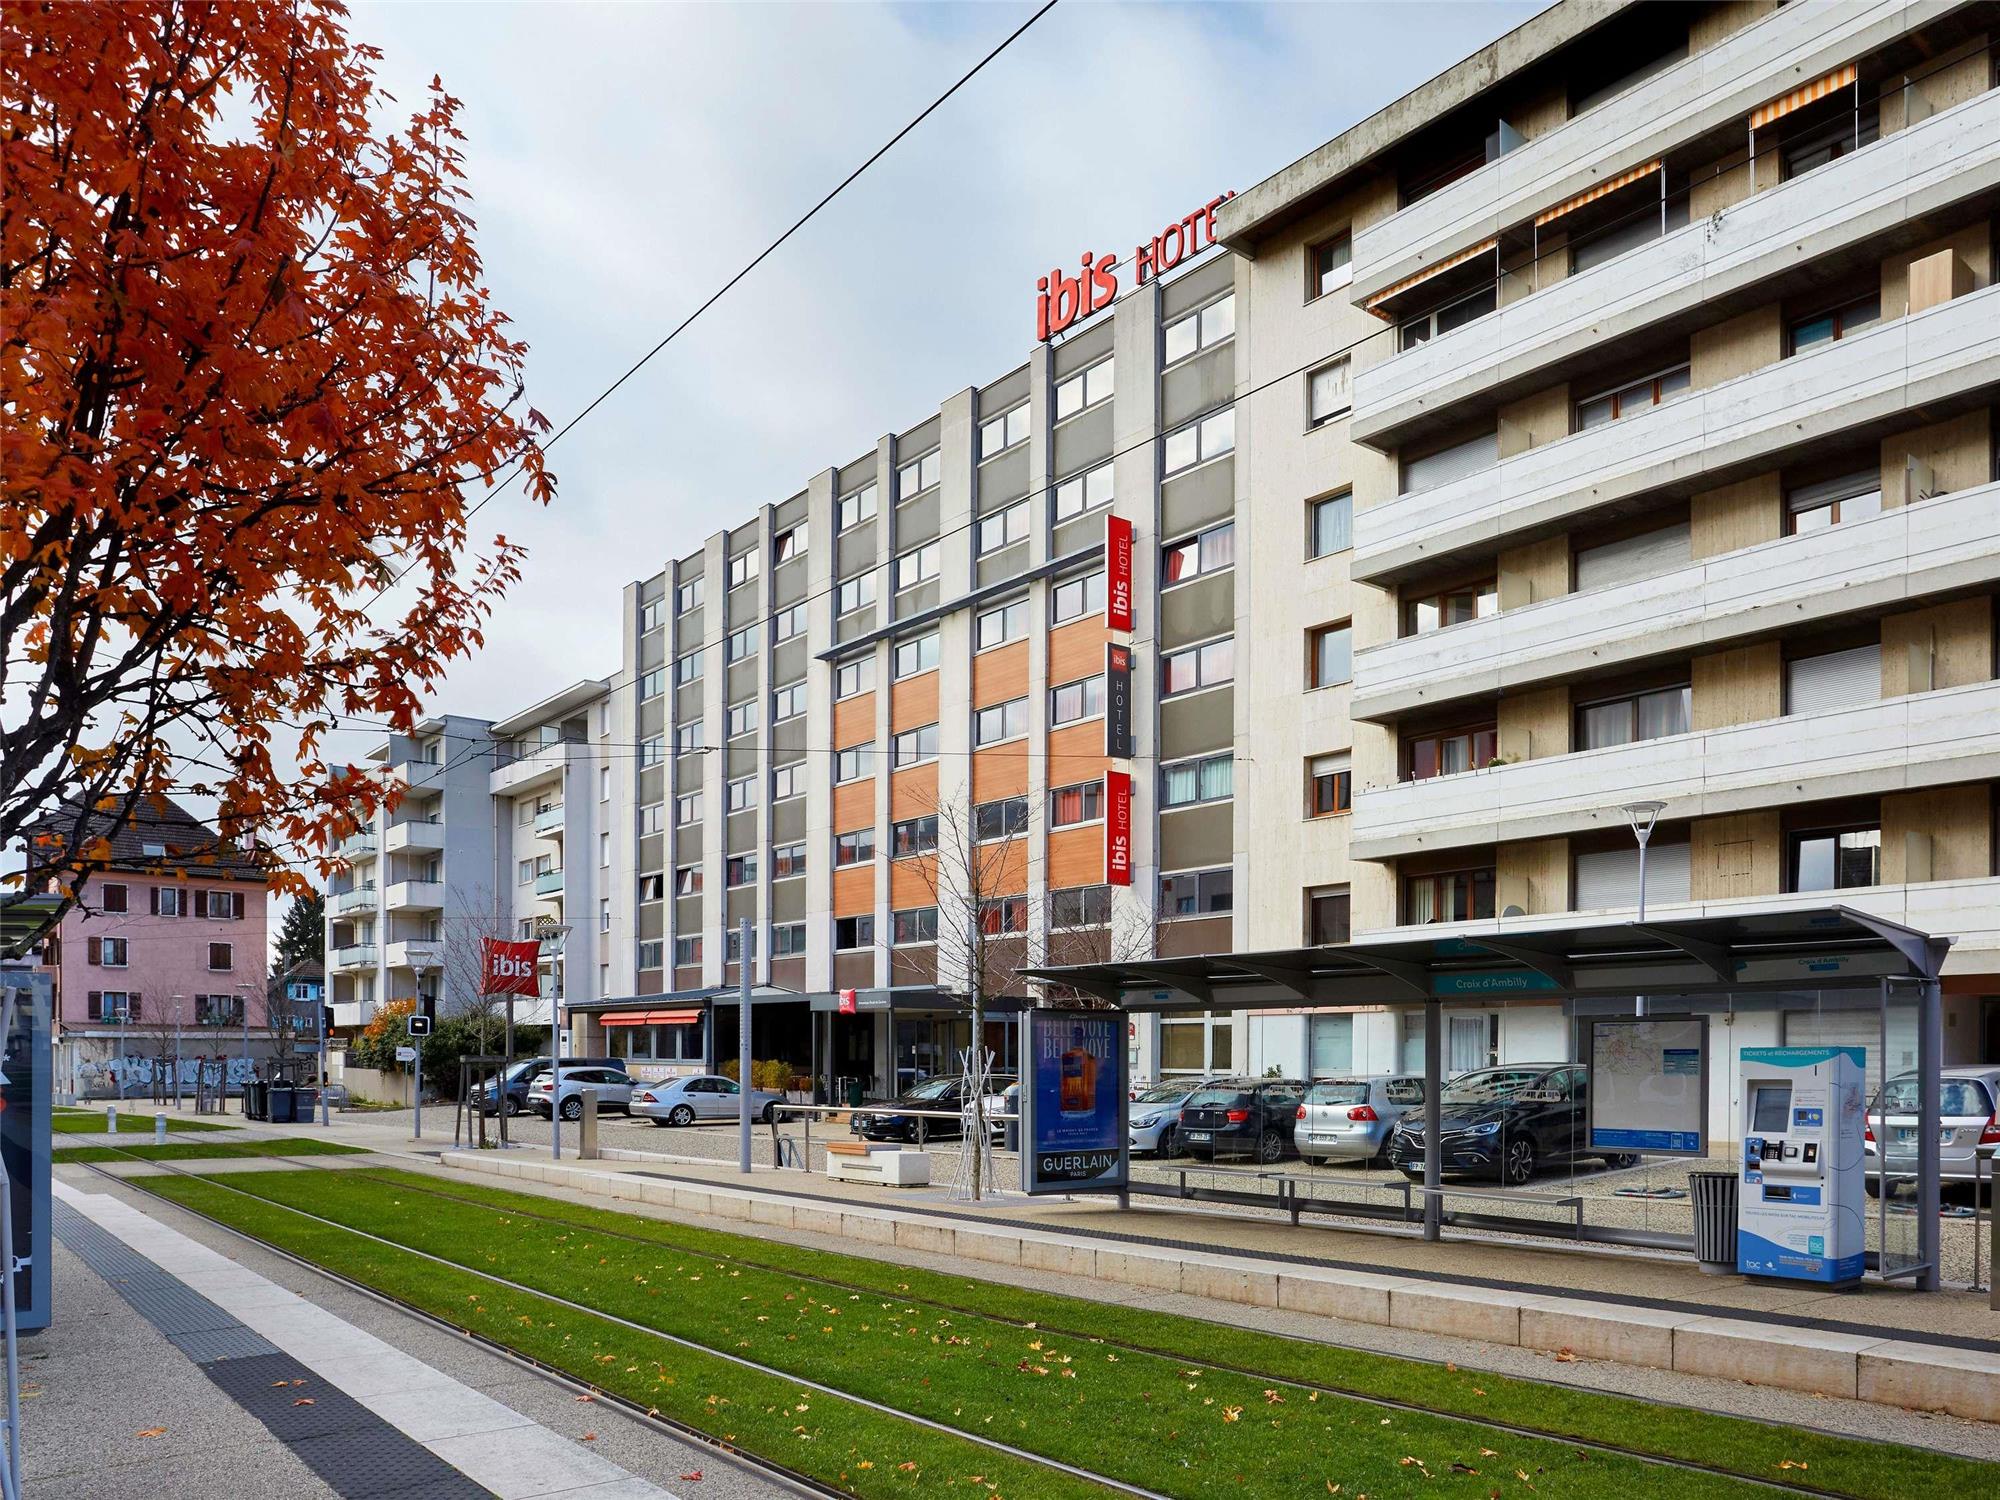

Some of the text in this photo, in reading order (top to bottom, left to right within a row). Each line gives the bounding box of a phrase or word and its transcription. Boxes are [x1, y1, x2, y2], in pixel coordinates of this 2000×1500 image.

[1037, 190, 1238, 342] ibis HOTE
[1113, 535, 1129, 616] ibis HOTEL
[1113, 655, 1127, 666] ibis
[1116, 680, 1124, 750] HOTEL
[1112, 788, 1127, 870] ibis HOTEL
[493, 953, 532, 977] ibis
[1456, 977, 1528, 989] Croix d'Ambilly
[1043, 1154, 1112, 1171] GUERLAIN
